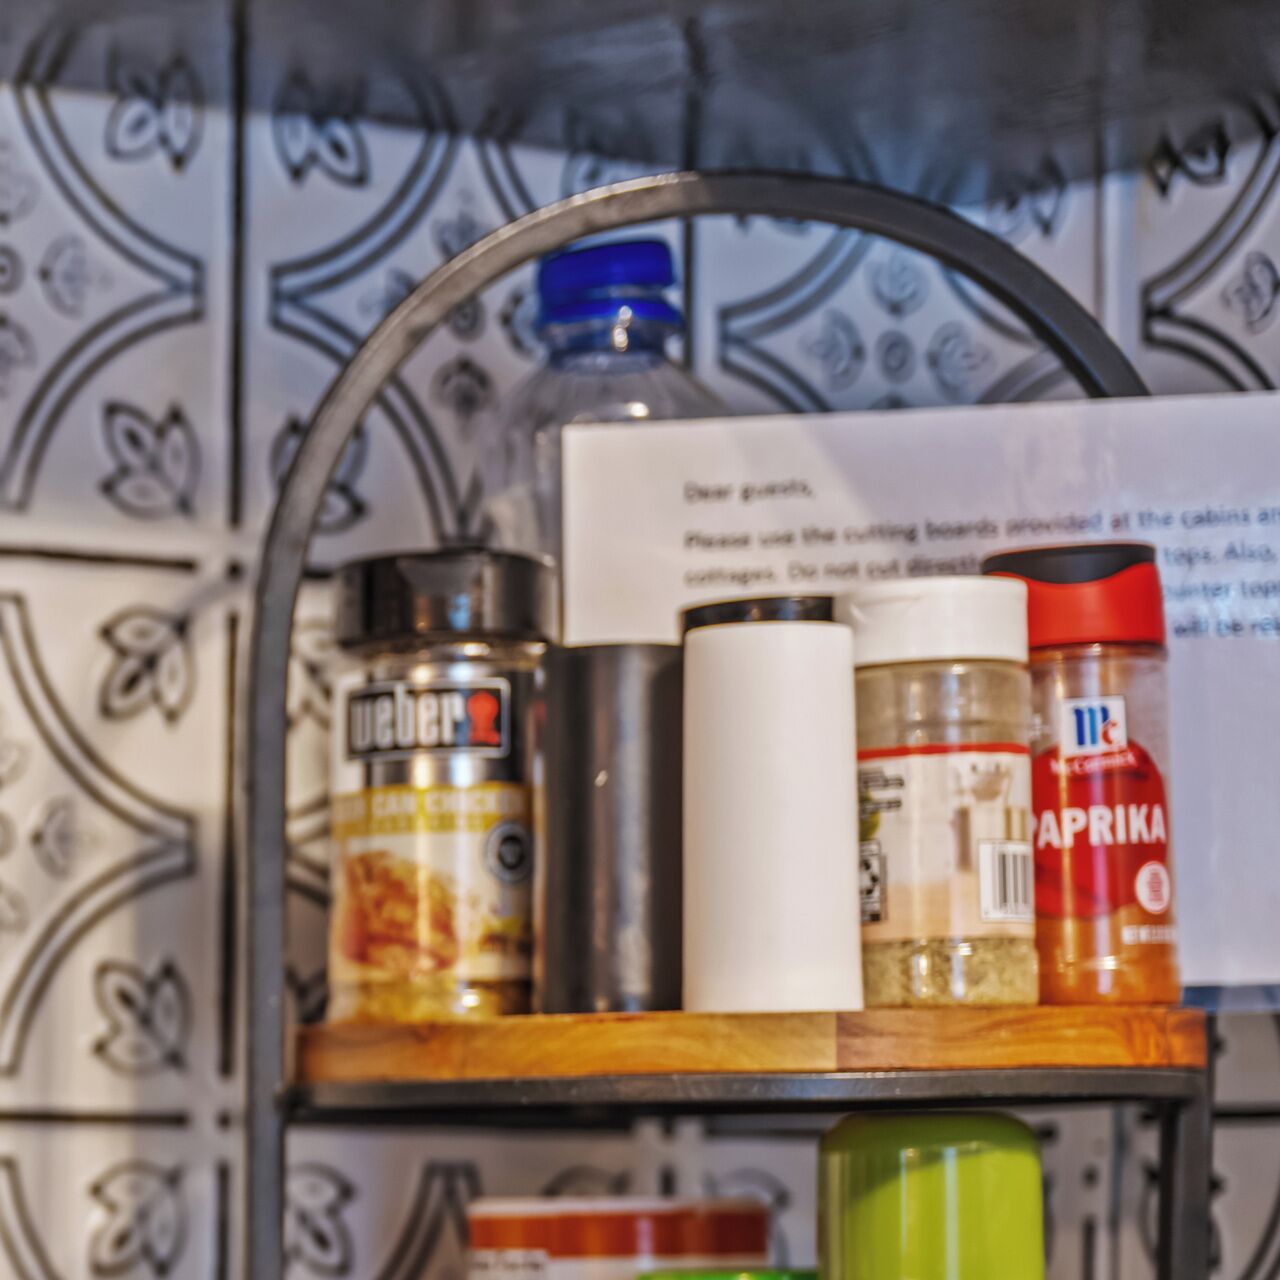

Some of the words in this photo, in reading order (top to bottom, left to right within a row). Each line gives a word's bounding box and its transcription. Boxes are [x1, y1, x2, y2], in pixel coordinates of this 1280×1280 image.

[684, 480, 734, 504] Dear
[740, 479, 814, 505] guests,
[684, 529, 751, 549] Please
[757, 531, 793, 546] use
[801, 525, 837, 544] the
[842, 522, 919, 545] cutting
[925, 516, 998, 543] boards
[1005, 510, 1105, 541] provided
[1111, 512, 1131, 532] at
[1138, 508, 1174, 528] the
[1180, 504, 1251, 528] cabins
[787, 557, 818, 577] Do
[822, 555, 860, 577] not
[865, 554, 901, 576] cut
[906, 547, 983, 577] directl
[349, 685, 466, 751] weber
